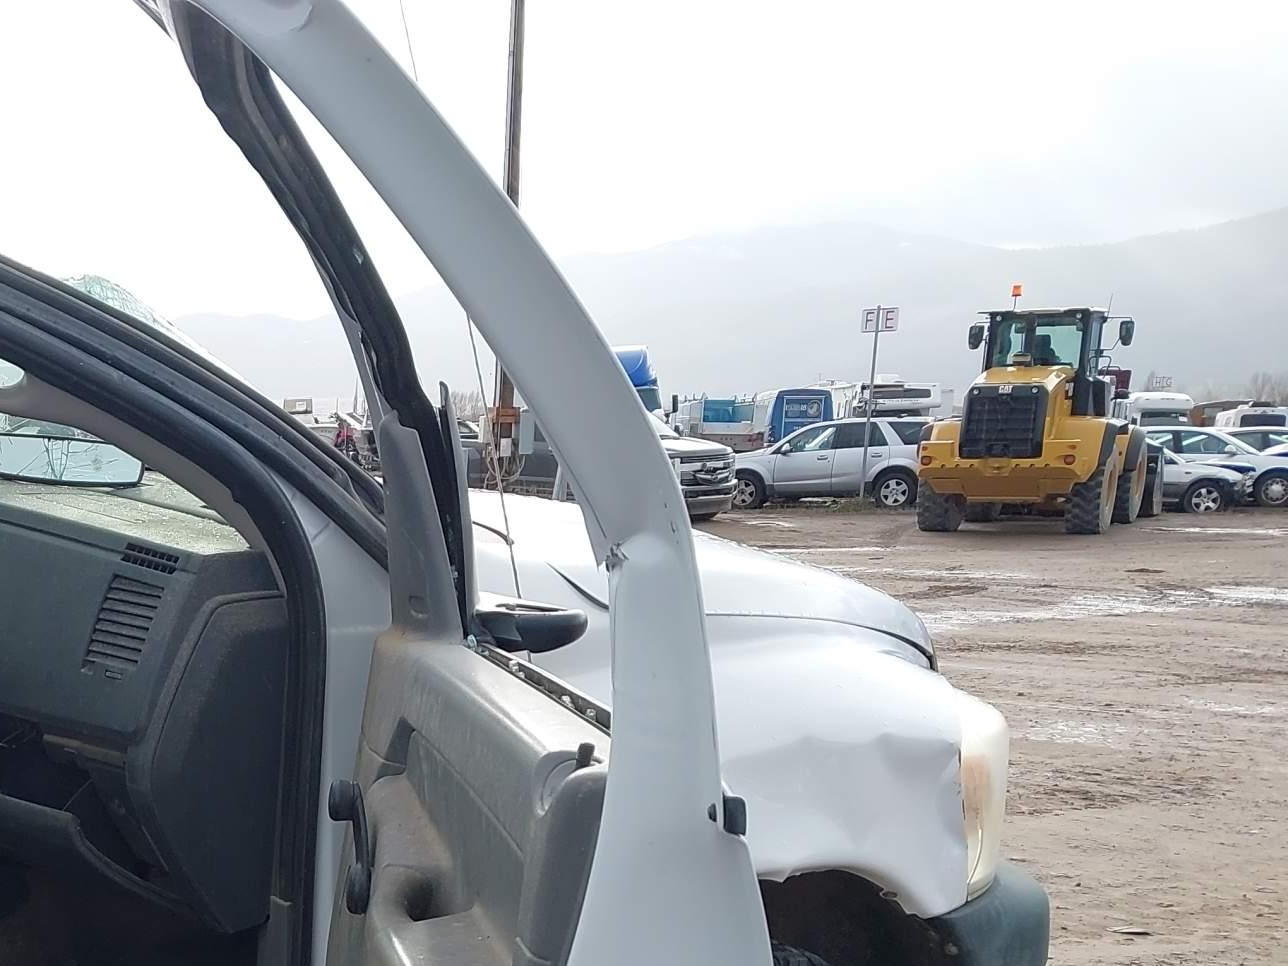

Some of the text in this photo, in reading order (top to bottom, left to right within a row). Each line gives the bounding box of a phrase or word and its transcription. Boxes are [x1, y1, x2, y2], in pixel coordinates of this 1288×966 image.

[864, 310, 896, 330] F E
[998, 385, 1014, 394] CAT
